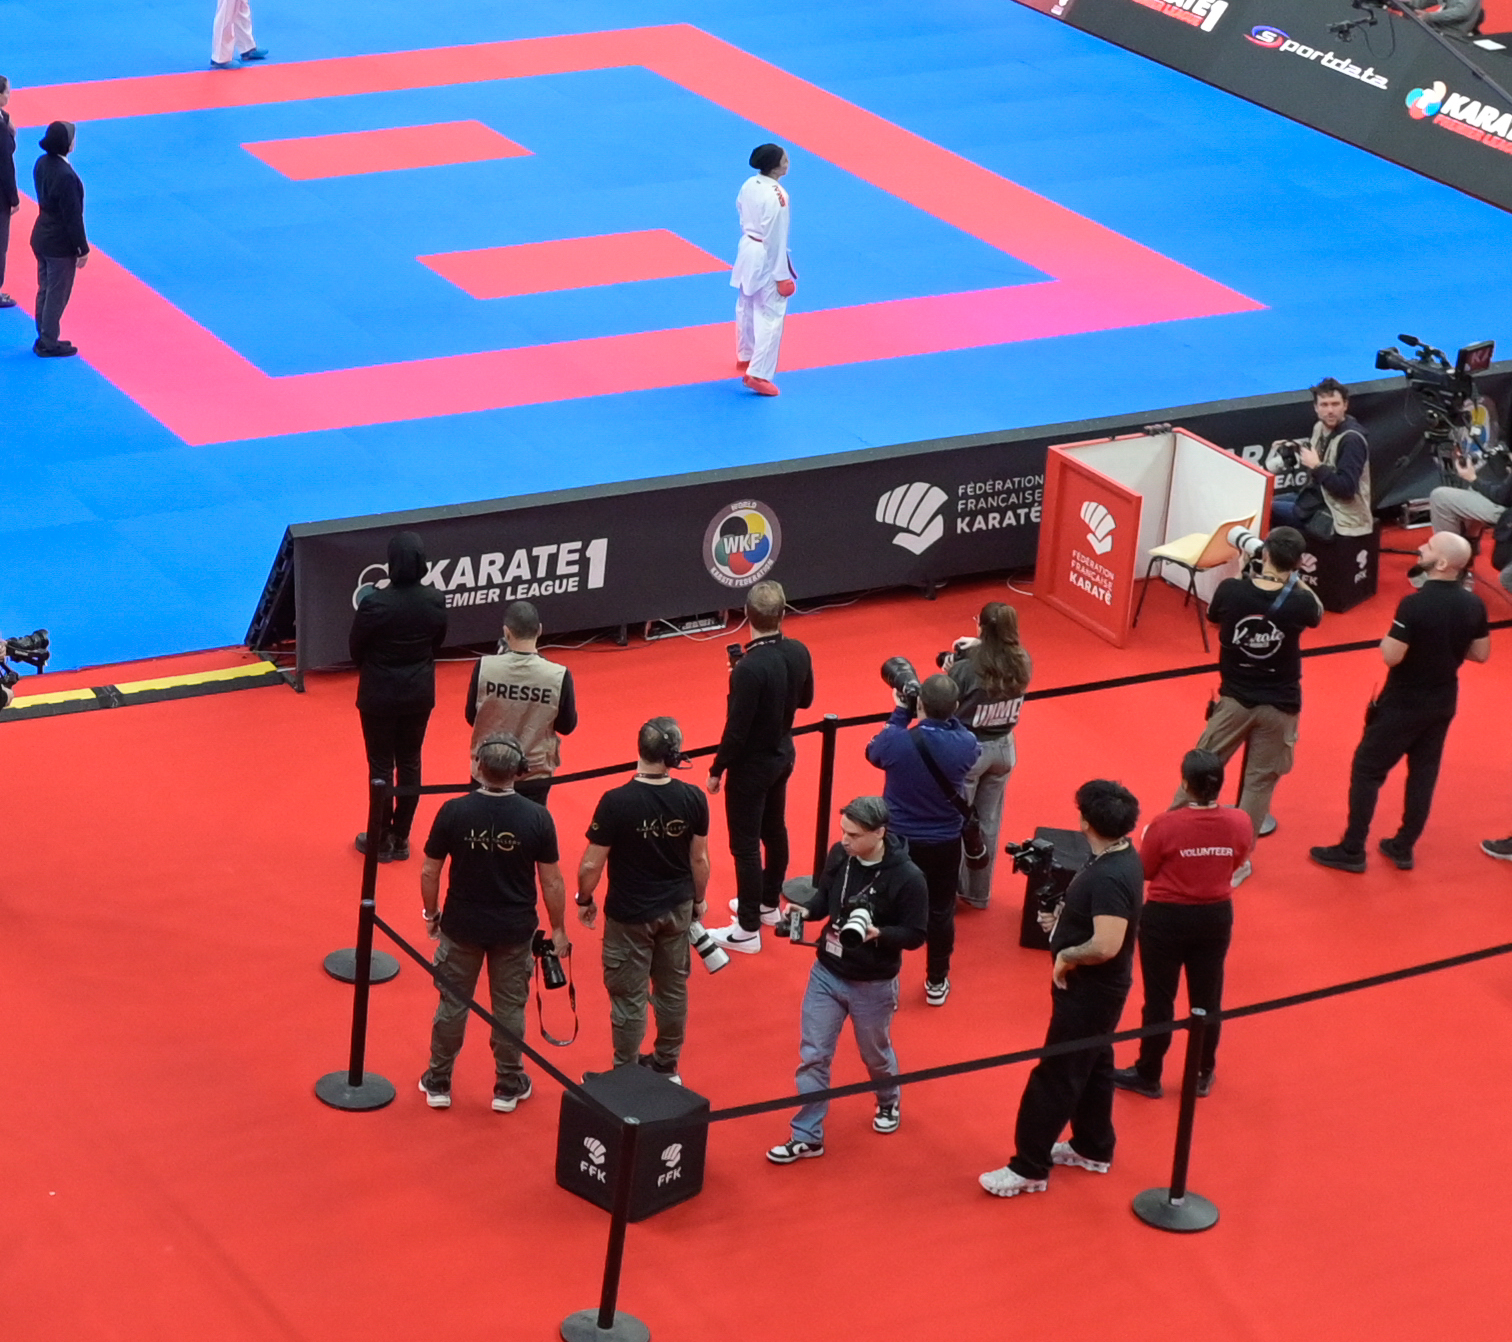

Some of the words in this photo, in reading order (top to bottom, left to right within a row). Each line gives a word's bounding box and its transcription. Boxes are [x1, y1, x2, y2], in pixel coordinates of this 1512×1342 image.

[958, 474, 1044, 497] FÉDÉRATION
[730, 501, 758, 512] WORLD
[957, 489, 1043, 513] FRANÇAISE
[956, 505, 1042, 534] KARATÉ
[724, 533, 762, 555] WKF
[709, 566, 734, 587] KARATE
[734, 557, 776, 587] FEDERATION
[1070, 559, 1114, 593] FRANÇAISE
[1072, 549, 1115, 581] FÉDÉRATION
[504, 577, 580, 601] LEAGUE
[1069, 570, 1113, 606] KARATÉ
[485, 681, 553, 704] PRESSE
[1179, 846, 1234, 858] VOLUNTEER
[579, 1161, 607, 1184] FFK
[657, 1166, 682, 1188] FFK
